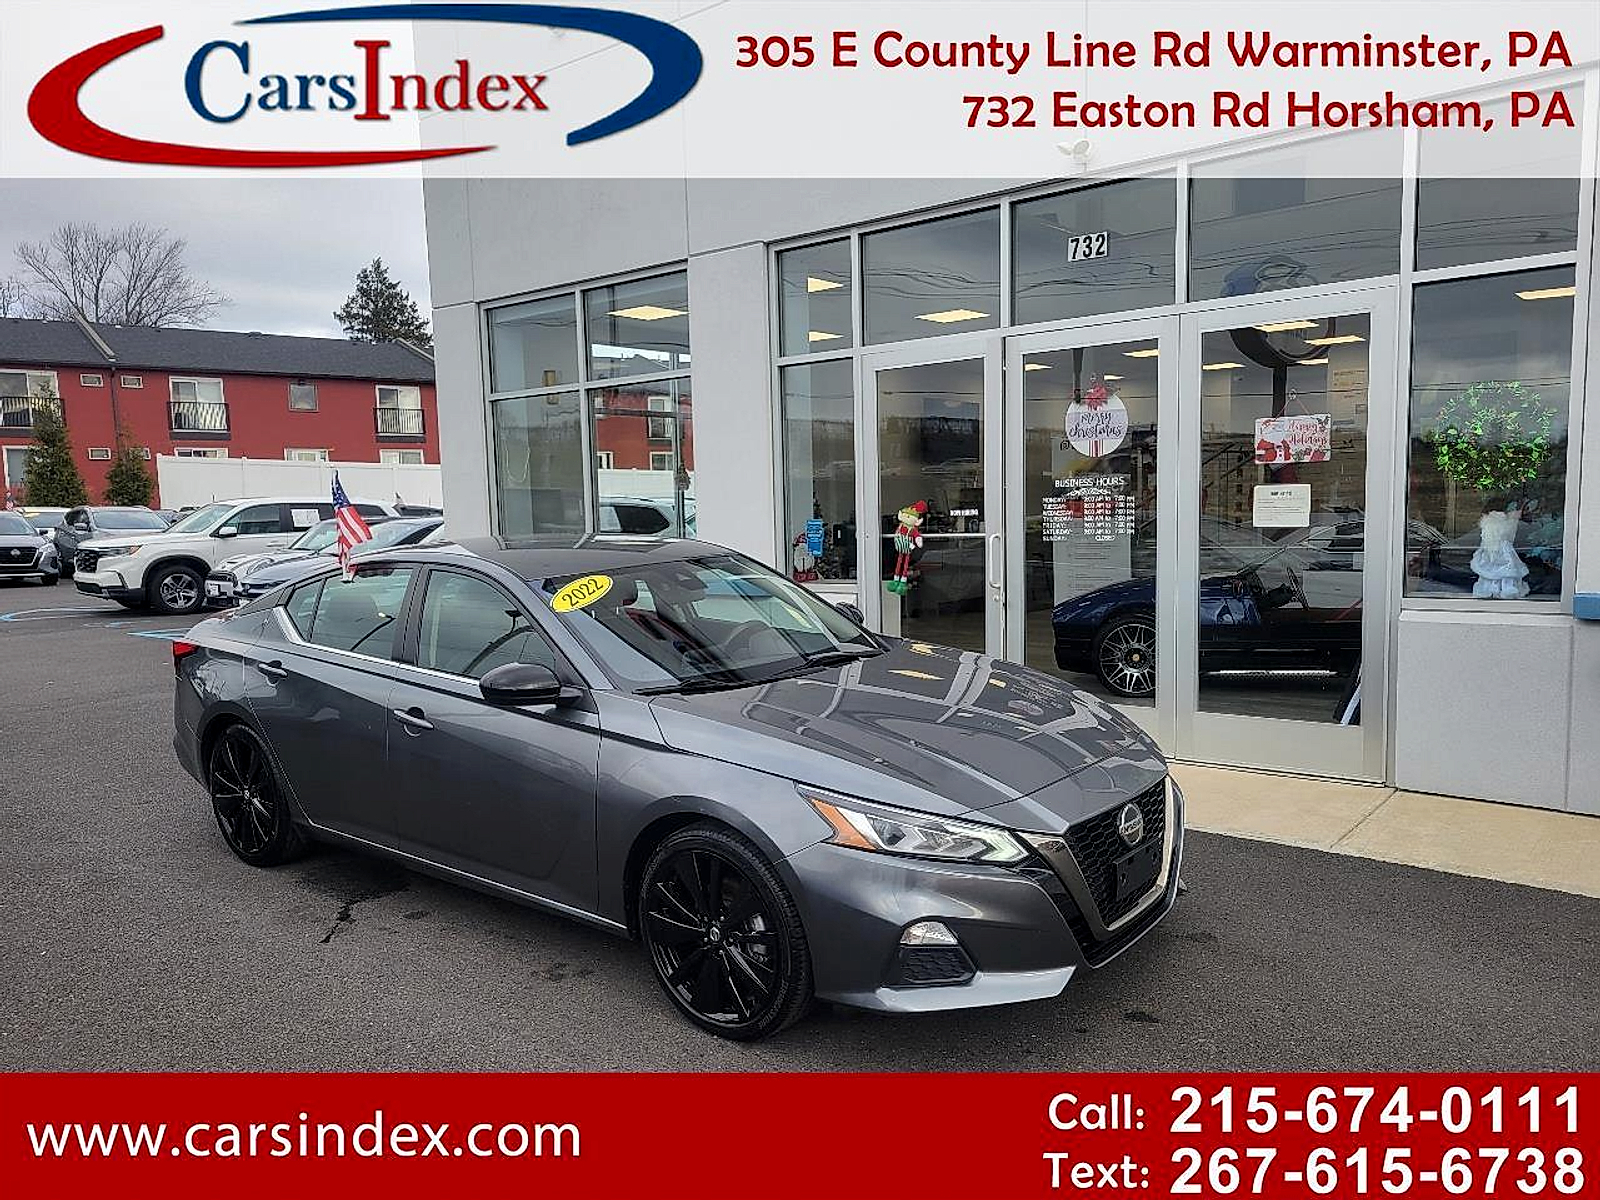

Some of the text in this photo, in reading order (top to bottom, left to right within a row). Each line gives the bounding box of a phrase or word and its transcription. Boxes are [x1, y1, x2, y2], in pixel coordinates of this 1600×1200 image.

[1070, 234, 1106, 260] 732
[1055, 476, 1125, 488] BUSINESS HOURS
[561, 578, 604, 607] 2022
